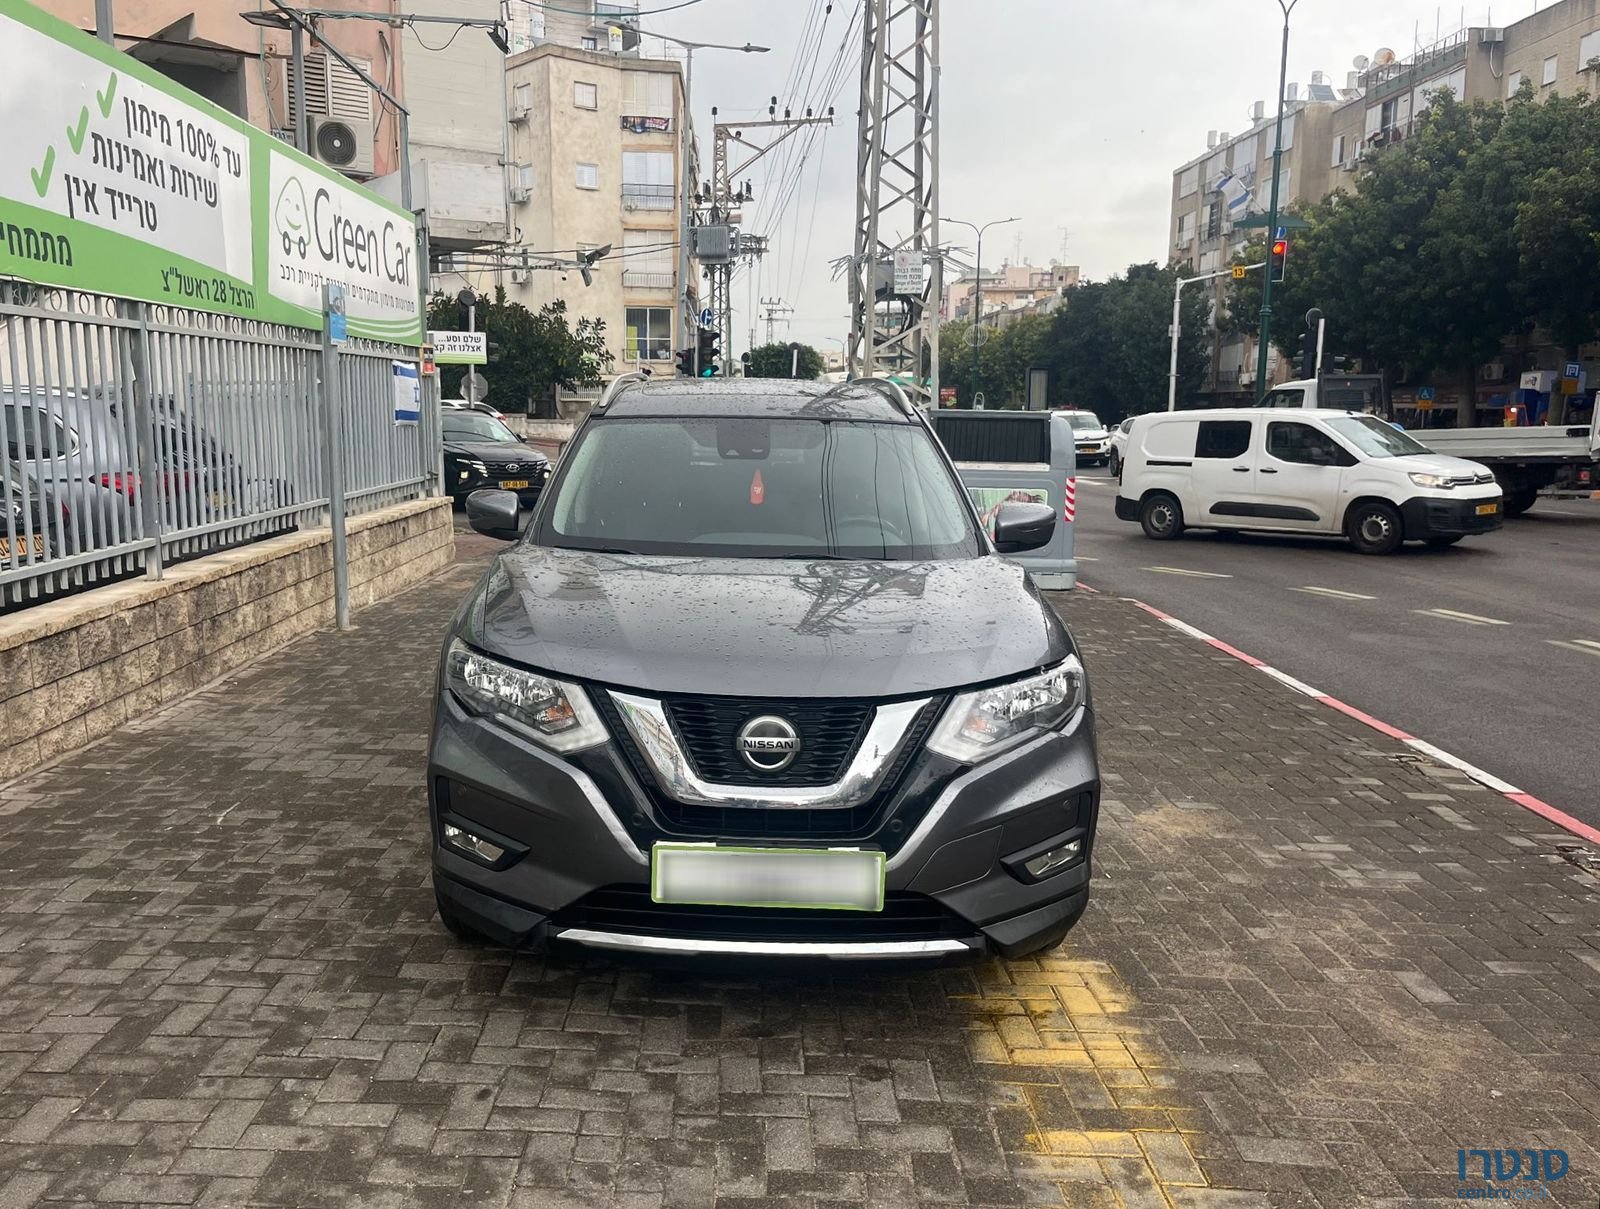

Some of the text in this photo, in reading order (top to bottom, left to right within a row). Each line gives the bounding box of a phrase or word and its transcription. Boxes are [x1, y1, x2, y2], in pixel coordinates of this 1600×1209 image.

[123, 97, 242, 178] עד 100% מימון
[91, 132, 218, 208] שירות ואמינות
[64, 174, 158, 232] טרייד אין
[314, 188, 411, 286] Green Car
[280, 264, 296, 282] רכב
[1234, 268, 1243, 276] 13
[212, 279, 226, 303] 28
[229, 281, 255, 309] הרצל
[352, 285, 378, 305] מתקדמים
[447, 344, 457, 352] זה
[460, 344, 482, 352] אצלנו
[463, 334, 482, 343] שלם
[743, 739, 794, 749] NISSAN
